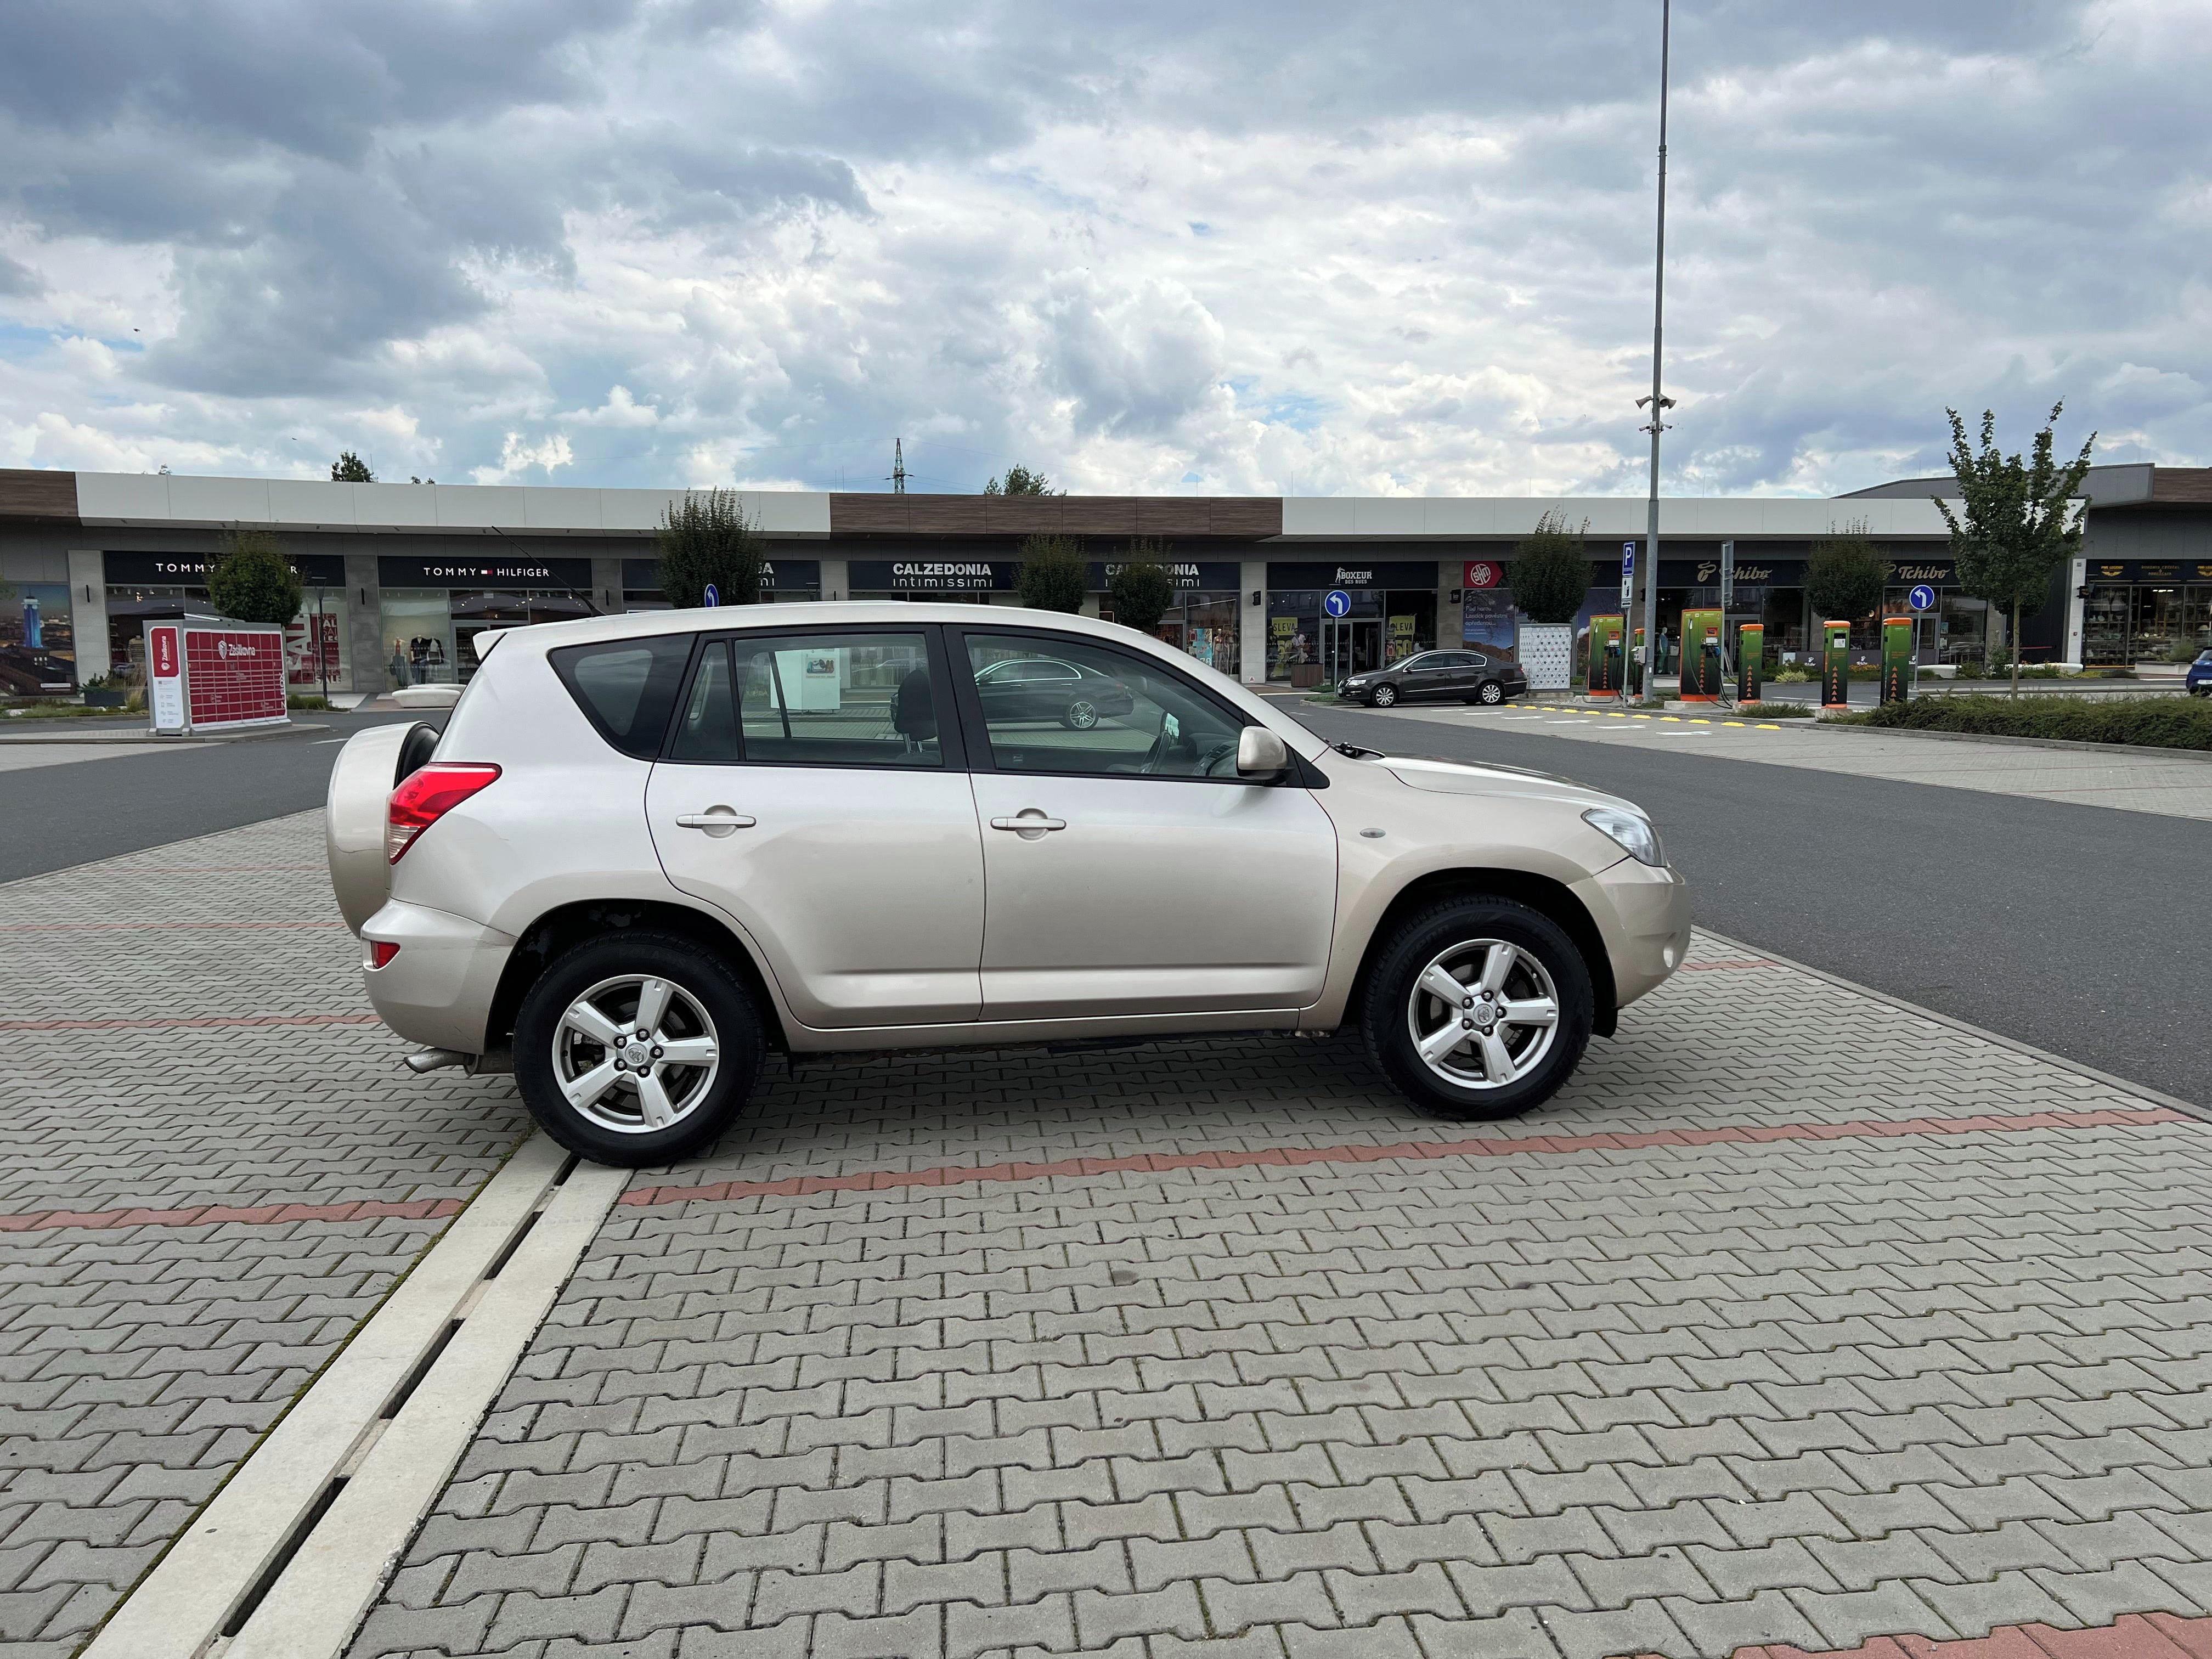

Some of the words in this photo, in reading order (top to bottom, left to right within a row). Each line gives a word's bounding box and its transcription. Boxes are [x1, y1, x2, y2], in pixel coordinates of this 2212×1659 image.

[1624, 546, 1632, 566] P
[155, 563, 216, 573] TOMMY
[424, 567, 477, 576] TOMMY
[496, 568, 549, 577] HILFIGER
[893, 563, 992, 575] CALZEDONIA
[1898, 566, 1951, 579] Tchibo
[1341, 571, 1372, 579] BOXEUR
[893, 577, 992, 587] intimissimi
[1273, 623, 1295, 632] SLEVA
[1392, 622, 1413, 631] LEVA
